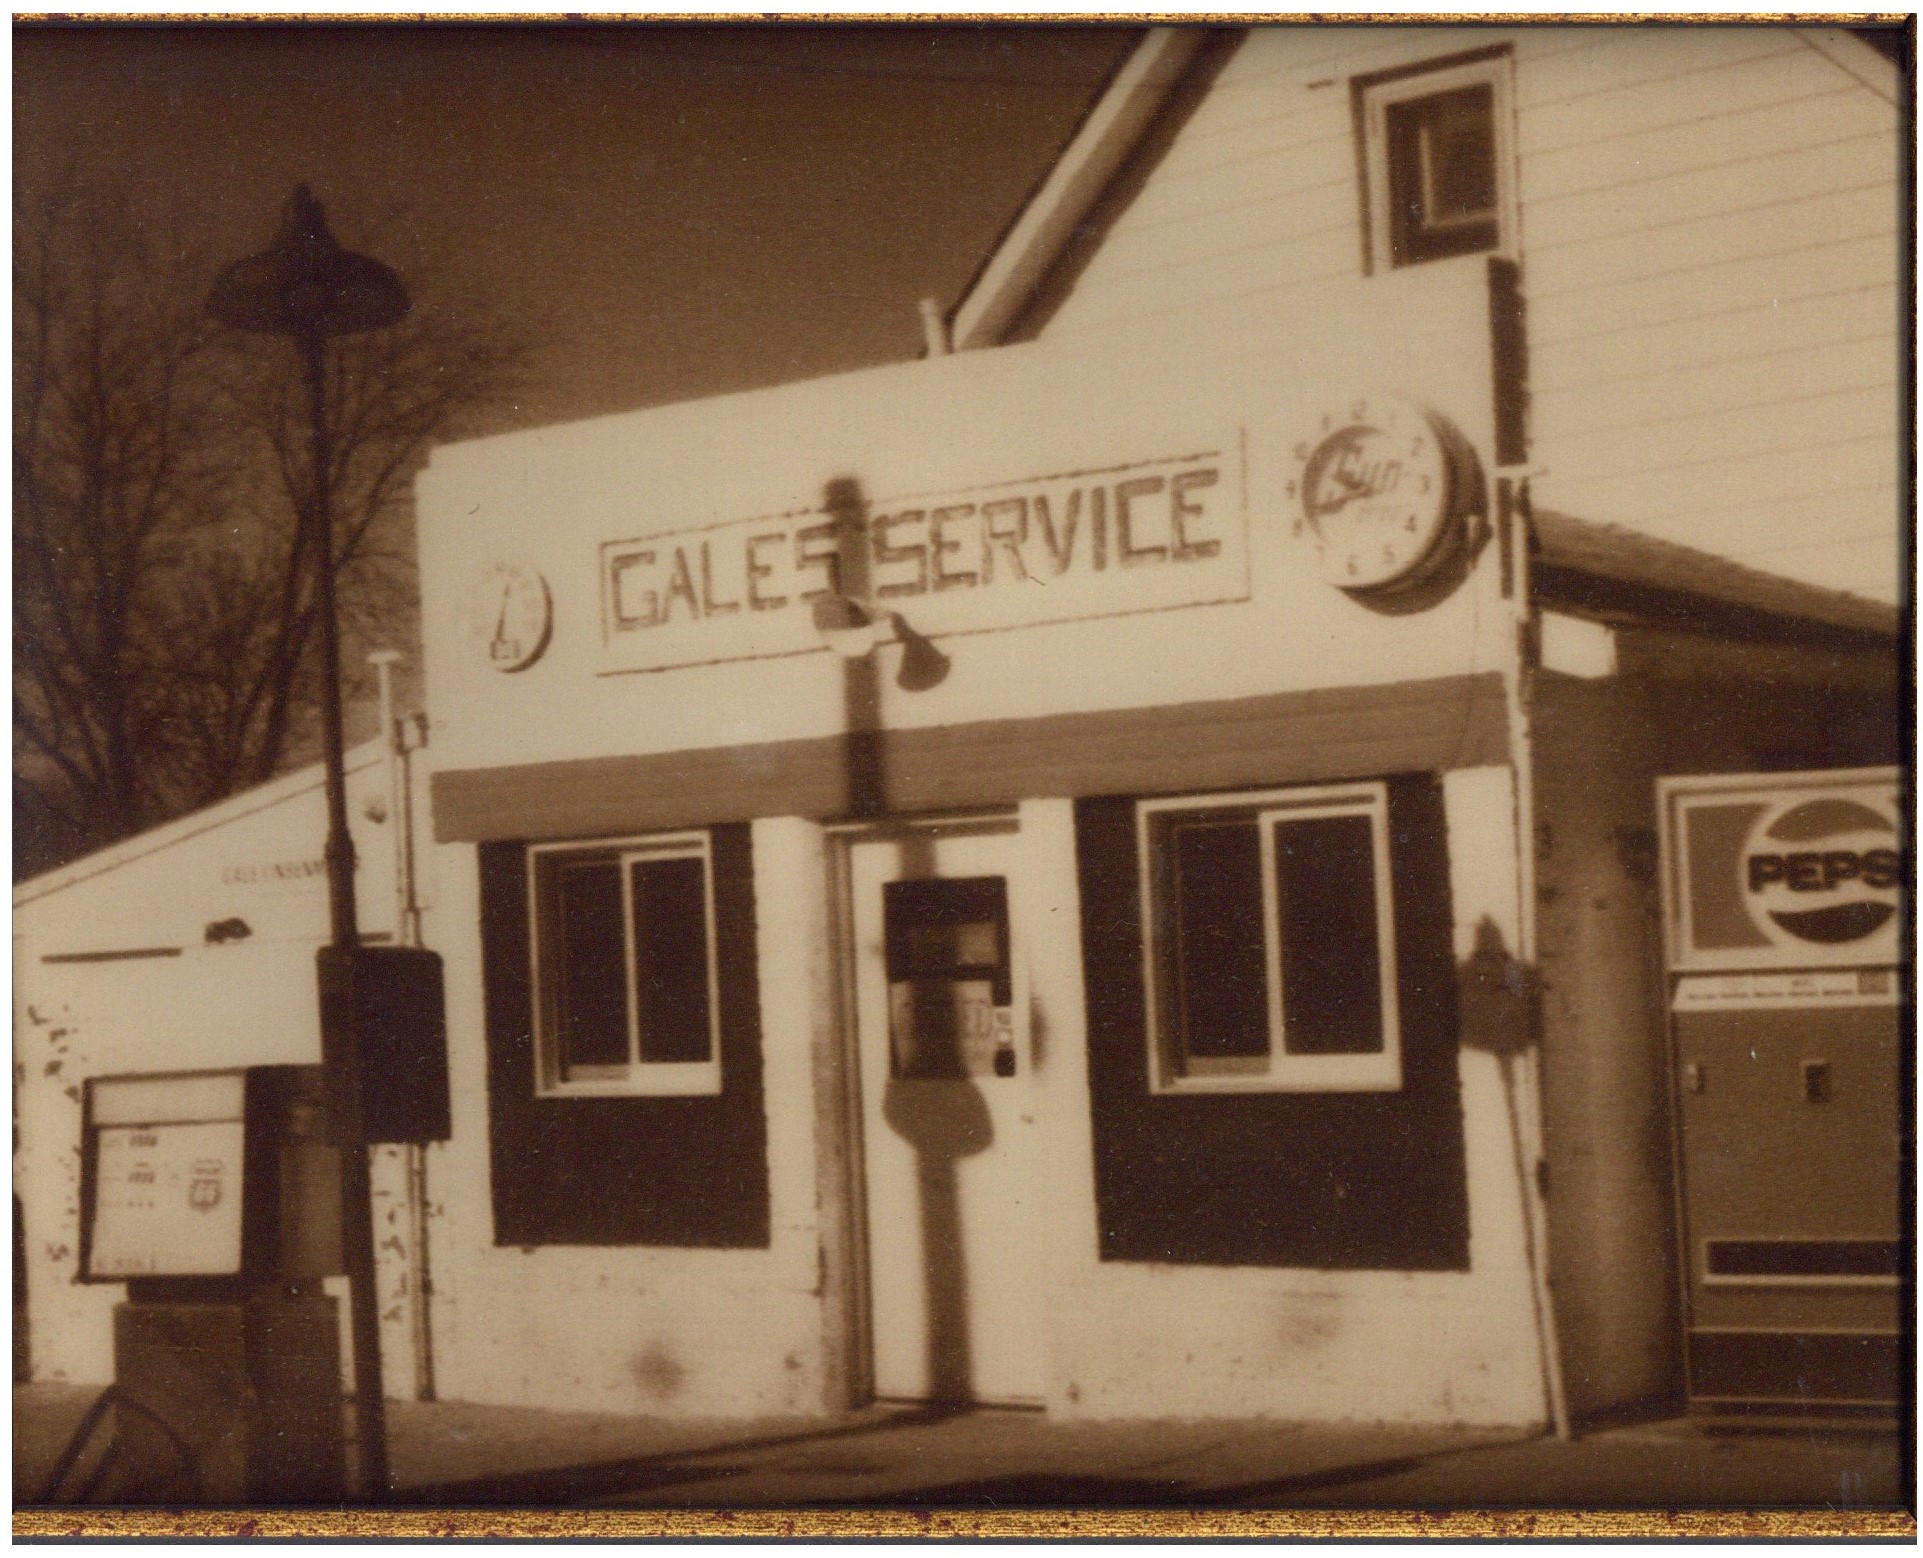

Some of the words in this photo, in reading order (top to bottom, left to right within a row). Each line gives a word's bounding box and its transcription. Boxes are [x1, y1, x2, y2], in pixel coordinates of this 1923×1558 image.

[609, 514, 844, 633] GALES
[870, 468, 1222, 600] SERVICE
[1404, 513, 1418, 534] 4
